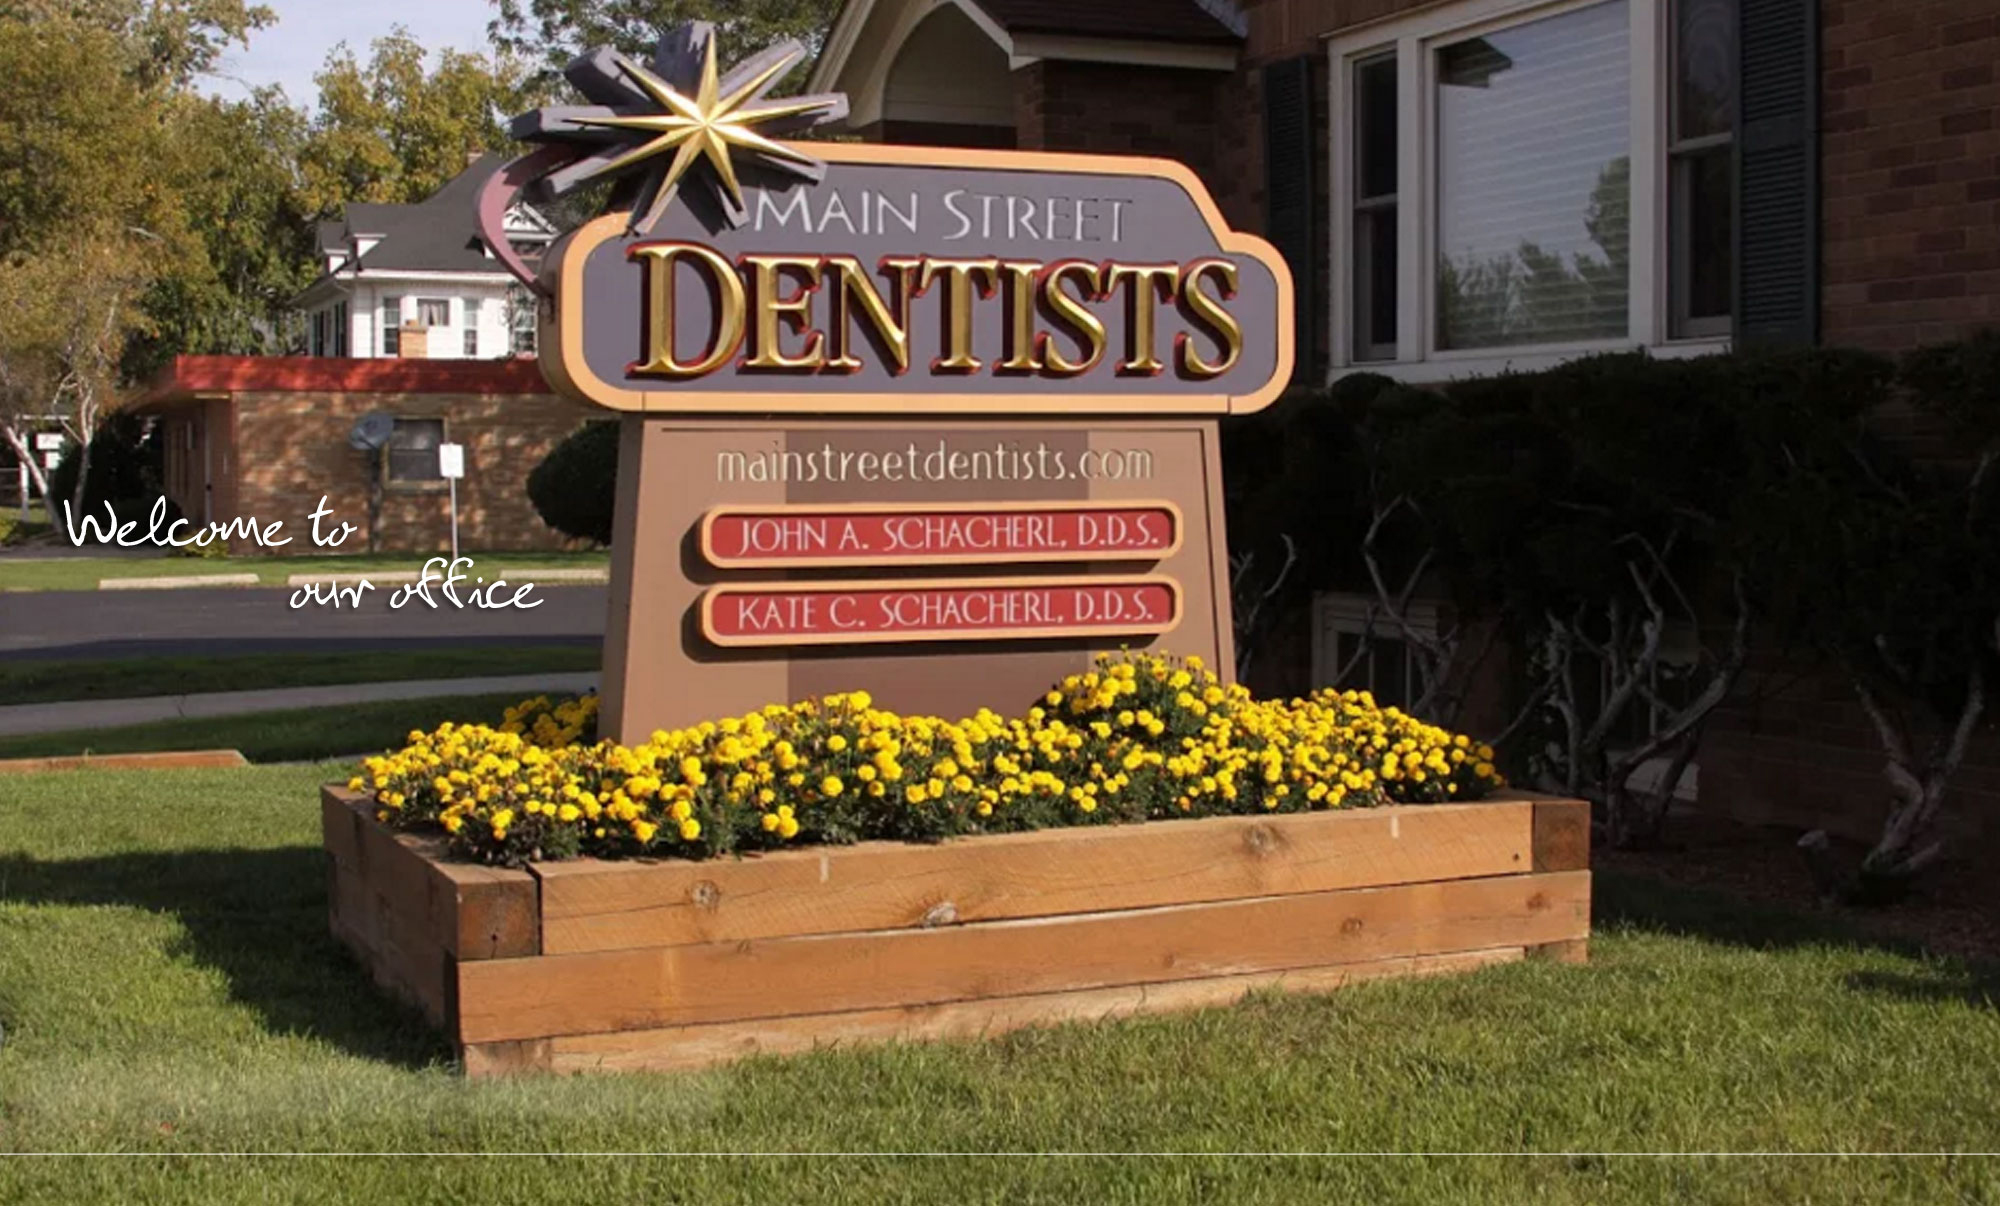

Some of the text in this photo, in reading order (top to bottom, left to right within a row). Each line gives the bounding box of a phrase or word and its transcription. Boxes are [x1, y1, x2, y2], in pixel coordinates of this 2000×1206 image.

[754, 186, 1132, 242] MAIN STREET
[624, 240, 1243, 380] DENTISTS
[716, 439, 1154, 482] mainstreetdentists.com
[738, 514, 1160, 556] JOHN A. SCHACHERL, D.D.S.
[738, 589, 1155, 630] KATE C. SCHACHERL, D.D.S.
